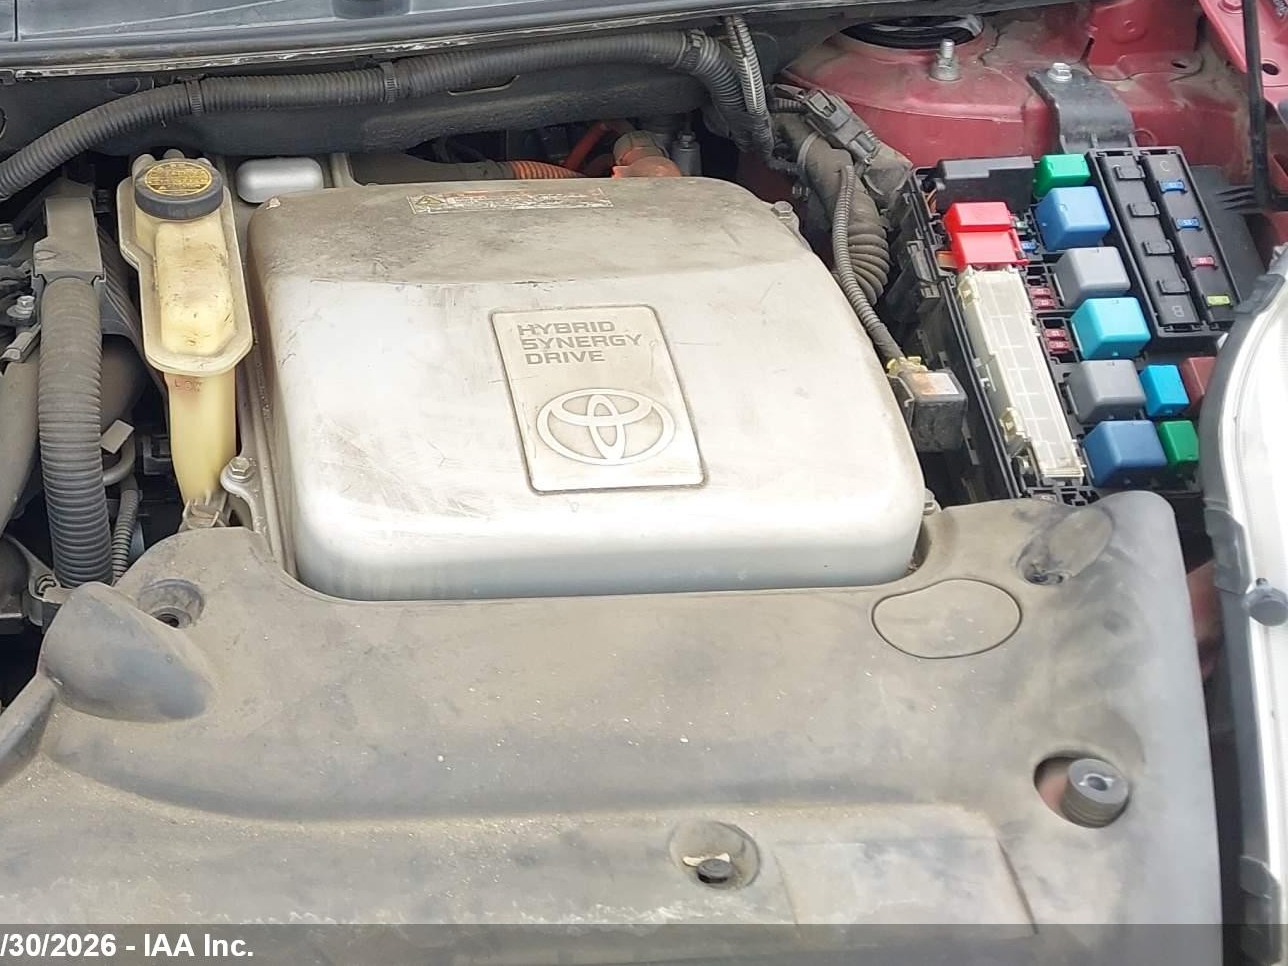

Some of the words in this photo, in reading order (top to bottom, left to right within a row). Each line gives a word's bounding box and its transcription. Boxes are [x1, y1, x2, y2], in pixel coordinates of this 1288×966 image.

[516, 320, 616, 336] HYBRID
[519, 333, 642, 351] SYNERGY
[524, 350, 606, 365] DRIVE
